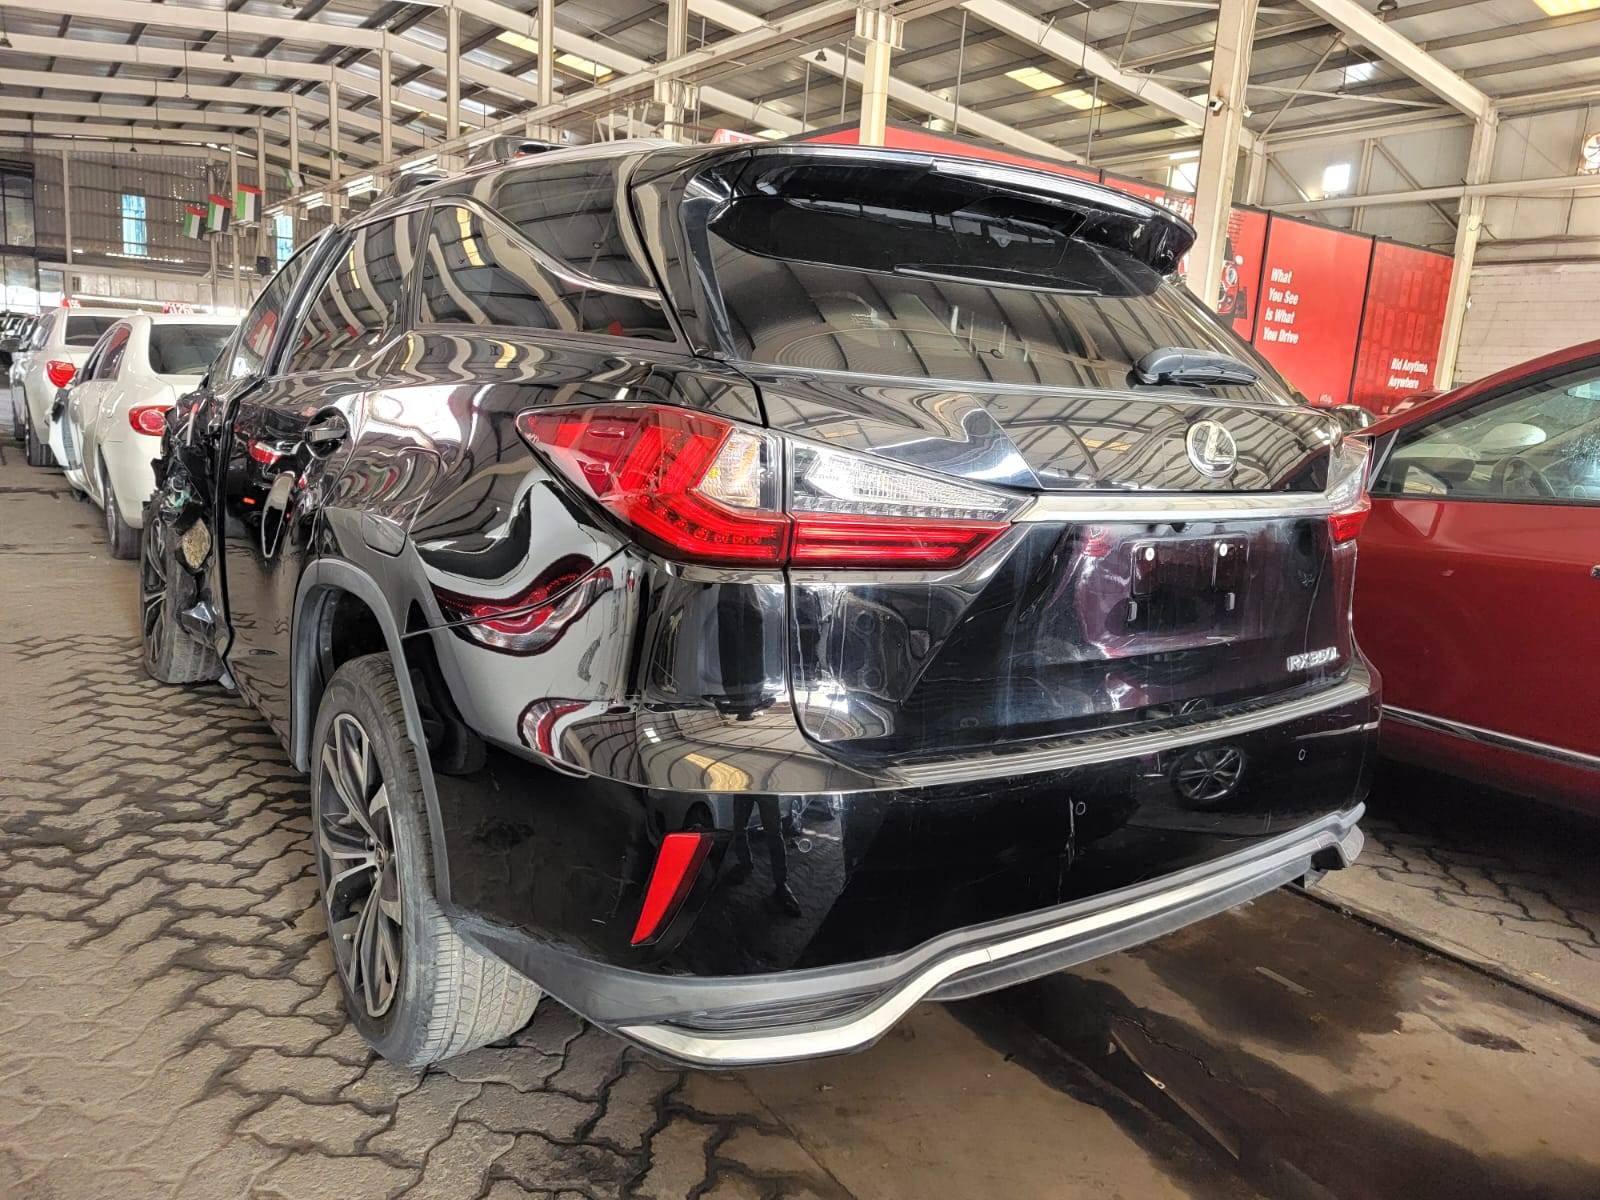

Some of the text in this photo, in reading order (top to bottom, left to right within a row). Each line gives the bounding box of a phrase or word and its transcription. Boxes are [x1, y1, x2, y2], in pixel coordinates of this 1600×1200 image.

[1271, 267, 1293, 284] What
[1269, 287, 1299, 305] You See
[1265, 307, 1295, 324] Is What
[1263, 326, 1299, 344] You Drive
[1391, 358, 1429, 376] Bid Anytime,
[1387, 375, 1419, 390] Anywhere
